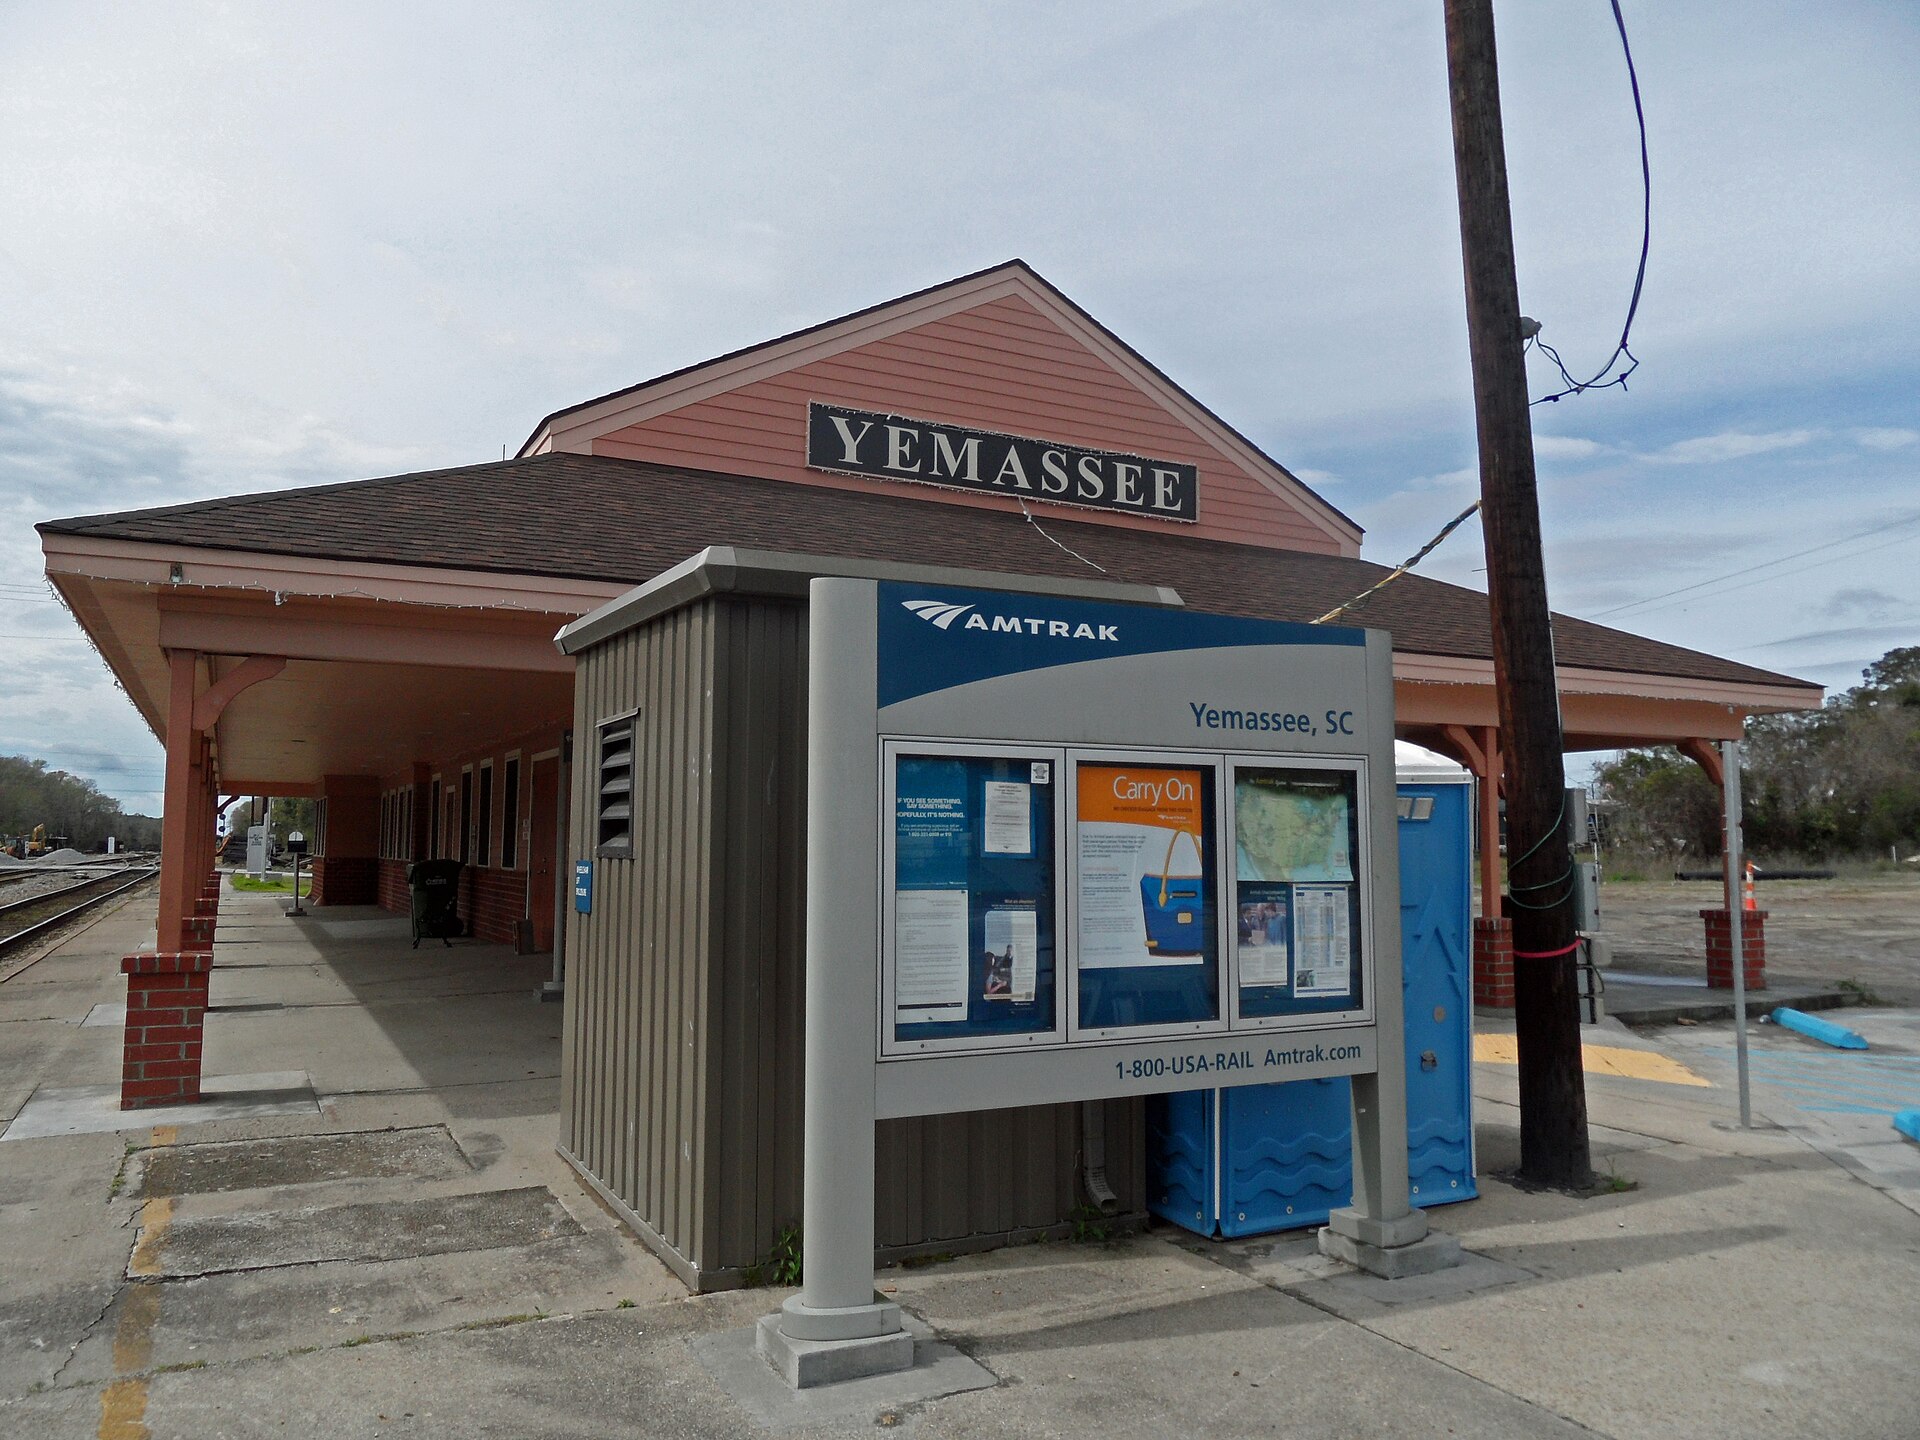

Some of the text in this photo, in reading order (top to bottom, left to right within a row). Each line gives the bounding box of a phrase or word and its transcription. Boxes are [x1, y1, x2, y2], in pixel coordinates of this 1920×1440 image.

[828, 414, 1182, 511] YEMASSEE
[964, 613, 1119, 642] AMTRAK
[1189, 702, 1353, 736] Yemassee, SC
[1113, 775, 1193, 806] Carry On
[1115, 1044, 1361, 1080] 1-800-USA-RAIL Amtrak.com
